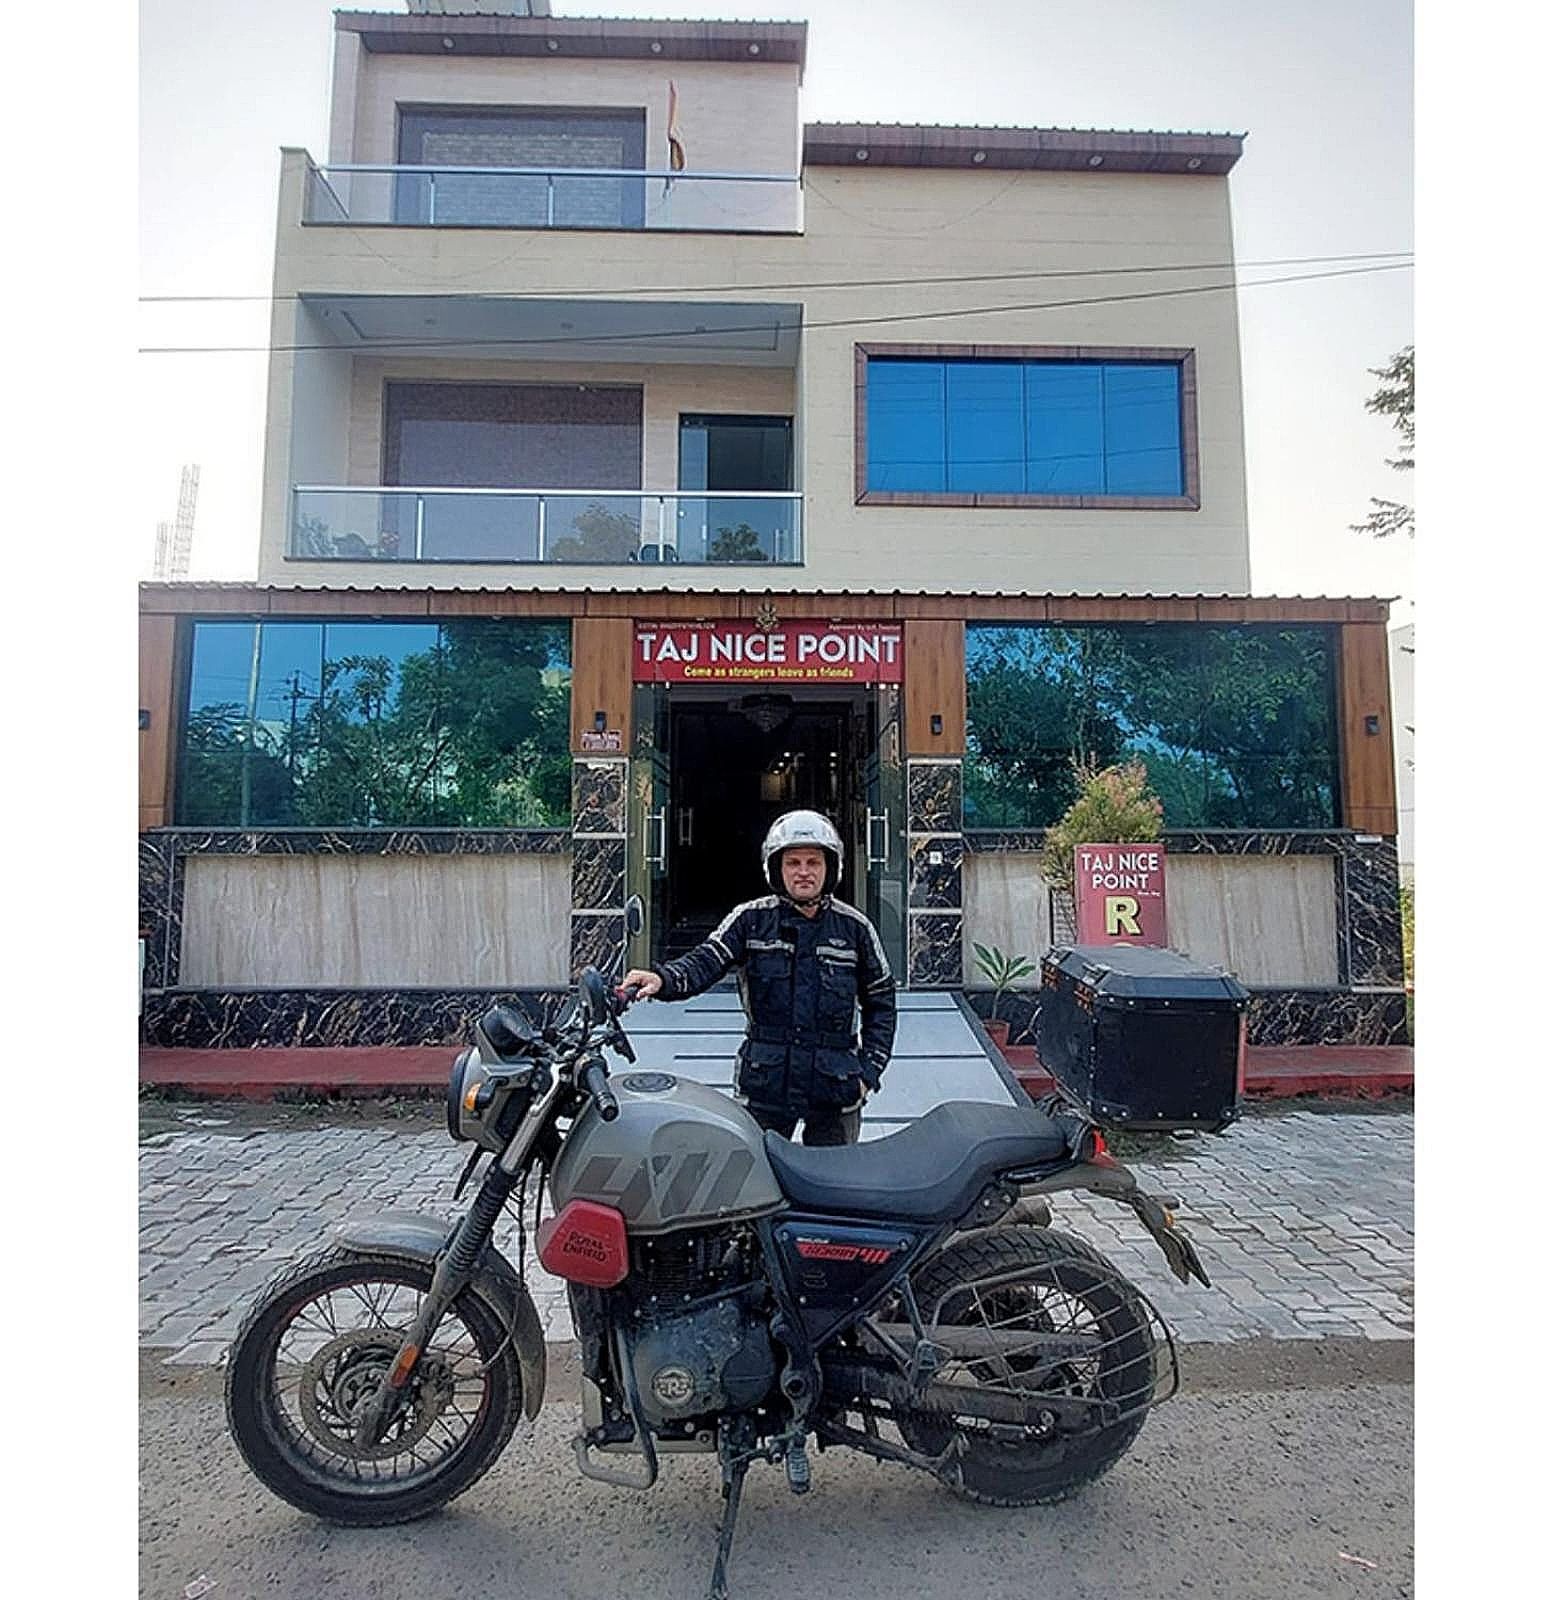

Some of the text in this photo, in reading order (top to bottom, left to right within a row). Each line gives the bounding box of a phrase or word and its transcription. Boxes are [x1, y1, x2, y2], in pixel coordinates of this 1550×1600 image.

[637, 633, 900, 663] TAJ NICE POINT
[684, 665, 854, 679] Come as strangers leave as friends
[1081, 852, 1159, 872] TAJ NICE
[1092, 873, 1149, 890] POINT
[1105, 896, 1141, 935] R
